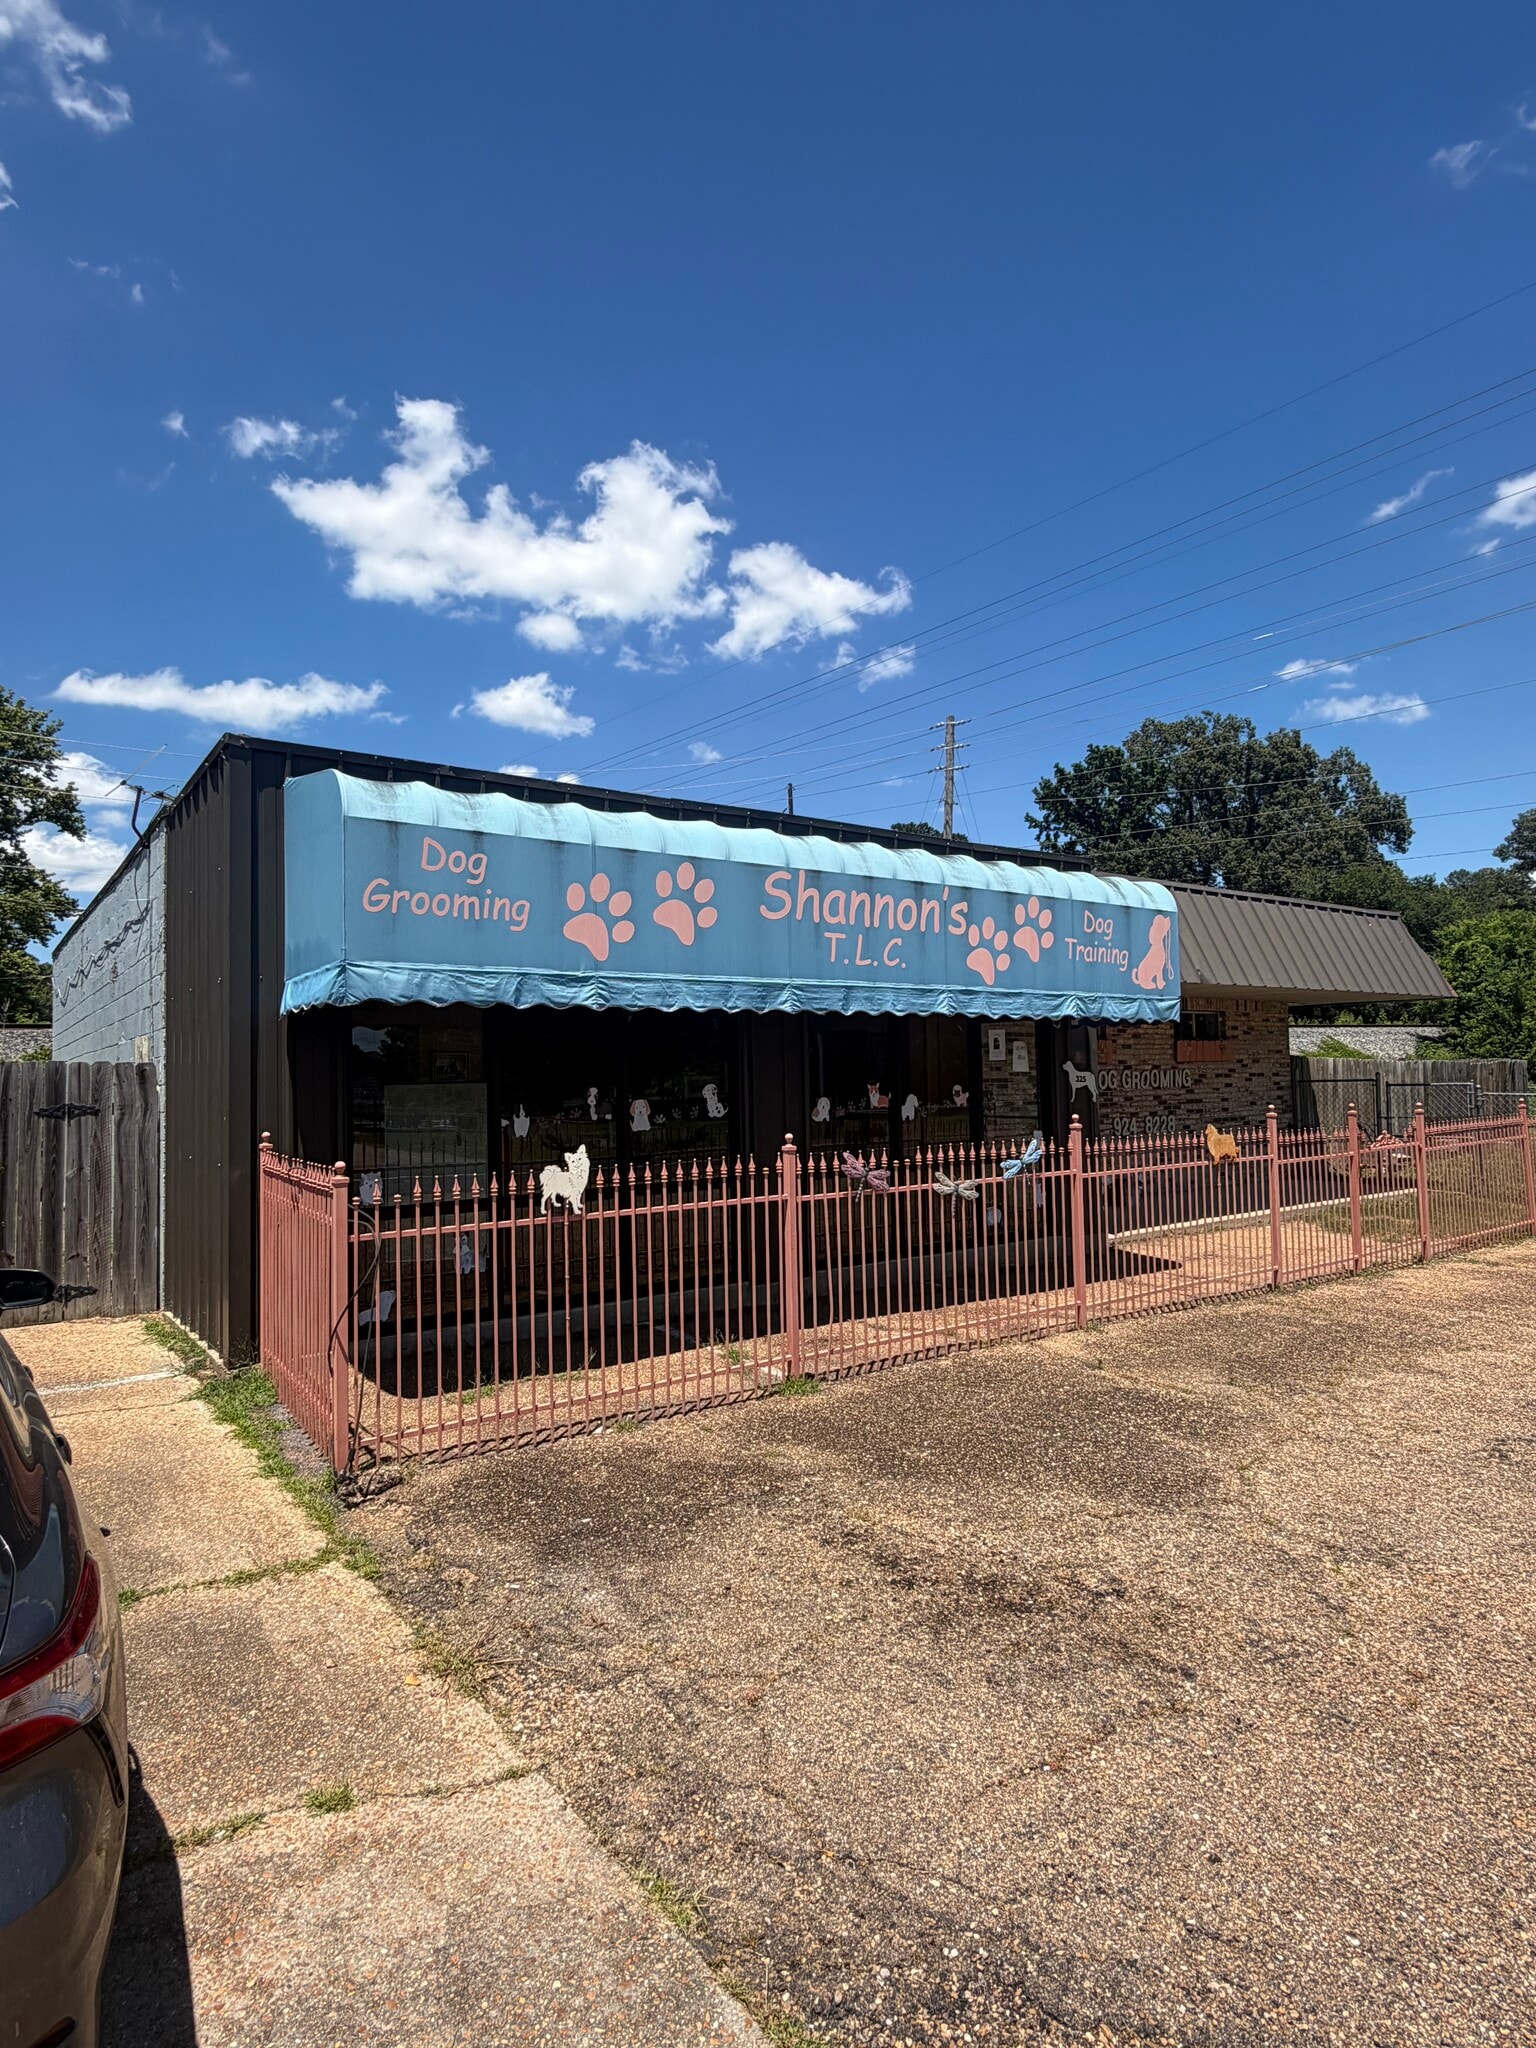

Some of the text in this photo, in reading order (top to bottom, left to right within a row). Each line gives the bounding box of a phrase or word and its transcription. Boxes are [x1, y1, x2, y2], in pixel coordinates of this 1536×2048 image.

[421, 836, 488, 886] Dog
[362, 877, 533, 932] Grooming
[759, 869, 969, 936] Shannon's
[1083, 909, 1114, 941] Dog
[823, 931, 907, 969] T.L.C.
[1064, 937, 1130, 972] Training
[1075, 1075, 1087, 1083] 325
[1098, 1068, 1192, 1090] OG GROOMING
